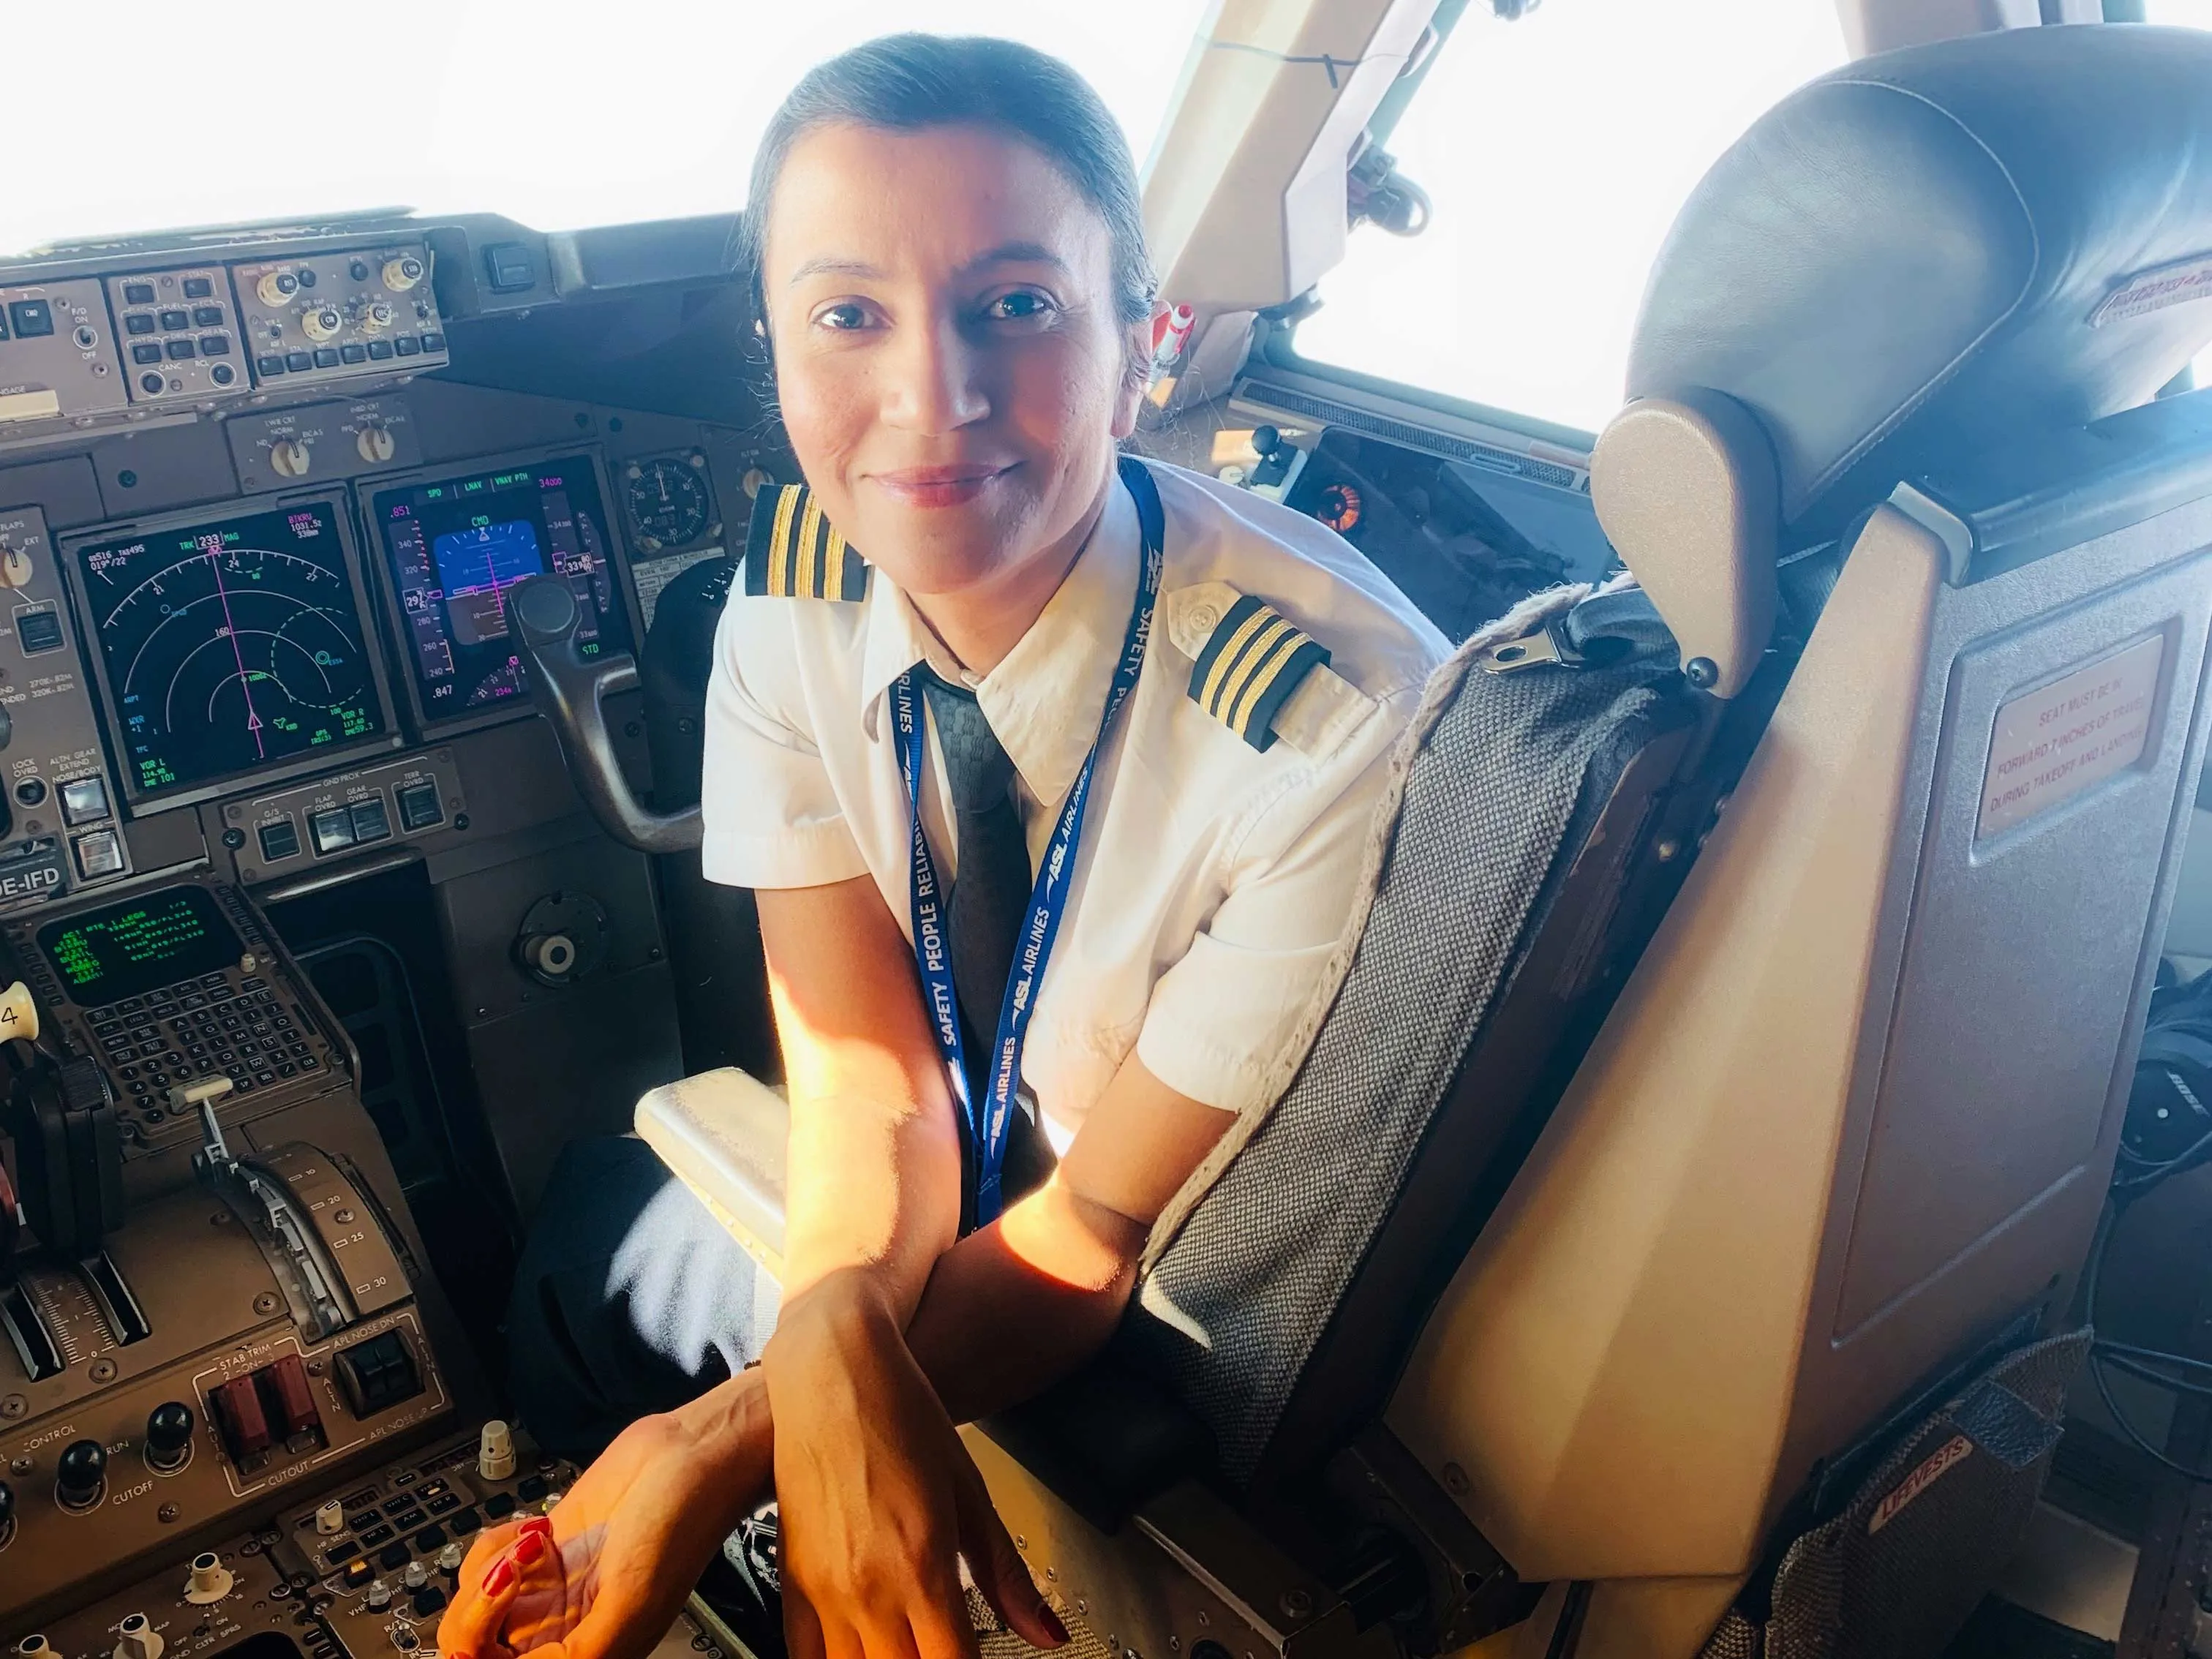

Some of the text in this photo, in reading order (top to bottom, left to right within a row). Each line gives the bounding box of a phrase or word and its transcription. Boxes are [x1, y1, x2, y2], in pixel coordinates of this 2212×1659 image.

[72, 307, 87, 316] F/D
[135, 335, 154, 343] HYD
[82, 351, 97, 360] OFF
[159, 363, 182, 372] CANC
[256, 439, 268, 447] ND
[427, 473, 563, 498] SPD LNAV VNAV PTH 34000
[636, 492, 645, 500] 50
[391, 505, 410, 518] .851
[472, 515, 489, 527] CMD
[644, 516, 652, 525] 40
[25, 536, 39, 546] EXT
[180, 533, 239, 551] TRK 233 MAG
[398, 540, 413, 549] 340
[228, 559, 240, 568] 24
[405, 565, 418, 575] 320
[306, 572, 318, 582] 27
[153, 585, 165, 595] 21
[26, 604, 45, 614] ARM
[417, 616, 431, 626] 280
[215, 626, 229, 637] 160
[423, 642, 437, 652] 260
[1124, 607, 1154, 677] SAFETY
[582, 644, 599, 655] STD
[429, 667, 443, 678] 240
[433, 685, 452, 699] .847
[898, 671, 913, 734] RLINES
[2039, 702, 2065, 726] SEAT
[2068, 689, 2096, 718] MUST
[2096, 682, 2111, 701] BE
[129, 715, 145, 725] WXR
[341, 710, 356, 721] VOR
[136, 745, 148, 754] TFC
[1997, 743, 2050, 778] FORWARD
[2058, 718, 2095, 748] INCHES
[50, 748, 97, 766] ALTN GEAR
[12, 758, 35, 770] LOCK
[59, 758, 90, 772] EXTEND
[139, 759, 157, 770] VOR
[13, 767, 38, 778] OVRD
[52, 765, 102, 783] NOSE/BODY
[161, 772, 175, 783] 101
[404, 771, 421, 780] TERR
[323, 772, 361, 788] GND PROX
[404, 777, 425, 788] OVRD
[1990, 783, 2030, 812] DURING
[2034, 758, 2077, 790] TAKEOFF
[2079, 747, 2099, 768] AND
[347, 785, 366, 796] GEAR
[315, 794, 332, 804] FLAP
[347, 792, 369, 803] OVRD
[315, 800, 336, 812] OVRD
[264, 808, 280, 819] G/S
[79, 822, 104, 834] WING
[1047, 766, 1088, 890] ASL AIRLINES
[914, 821, 957, 1047] SAFETY PEOPLE RELIABI
[1012, 906, 1050, 1019] ASL AIRLINES
[1, 1007, 18, 1025] 4
[304, 1058, 315, 1066] CLR
[996, 1037, 1016, 1102] AIRLINES
[2167, 1071, 2210, 1117] BOSE
[328, 1195, 341, 1205] 20
[351, 1232, 364, 1243] 25
[373, 1276, 387, 1288] 30
[334, 1317, 396, 1349] APL NOSE DN
[219, 1343, 272, 1371] STAB TRIM
[418, 1337, 436, 1372] ALTN
[222, 1371, 231, 1381] 2
[323, 1378, 342, 1413] ALTN
[370, 1426, 387, 1440] APL
[23, 1425, 77, 1453] CONTROL
[208, 1425, 226, 1462] AUTO
[106, 1440, 130, 1456] RUN
[268, 1462, 309, 1487] CUTOUT
[113, 1481, 154, 1505] CUTOFF
[386, 1499, 401, 1508] VHF
[353, 1516, 366, 1524] VHF
[404, 1513, 418, 1522] AM
[317, 1530, 352, 1550] HF SENS
[348, 1603, 366, 1617] VHF
[154, 1621, 170, 1633] MAP
[217, 1617, 229, 1626] ON
[383, 1620, 400, 1633] R/T
[174, 1636, 188, 1647] OFF
[195, 1636, 216, 1650] CLTR
[220, 1624, 242, 1639] SPRS
